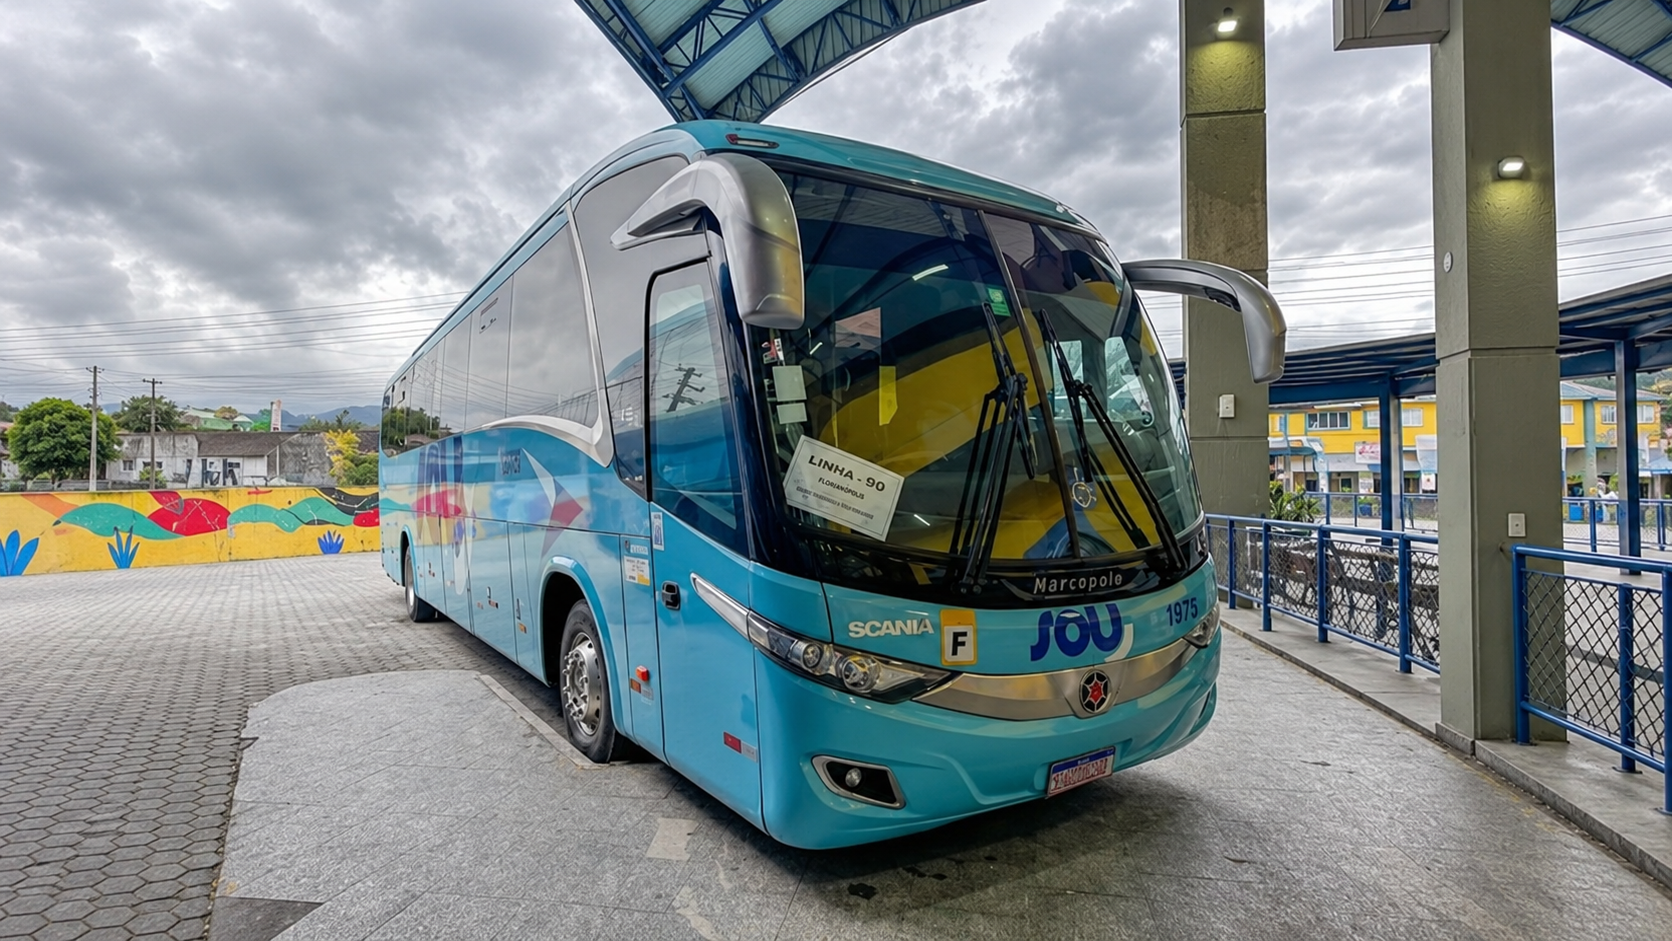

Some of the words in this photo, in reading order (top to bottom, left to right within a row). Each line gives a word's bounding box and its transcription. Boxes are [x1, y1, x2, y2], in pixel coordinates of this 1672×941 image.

[808, 455, 854, 481] LINHA
[866, 476, 886, 492] 90
[1166, 597, 1199, 627] 1975
[848, 618, 935, 638] SCANIA
[951, 631, 968, 656] F
